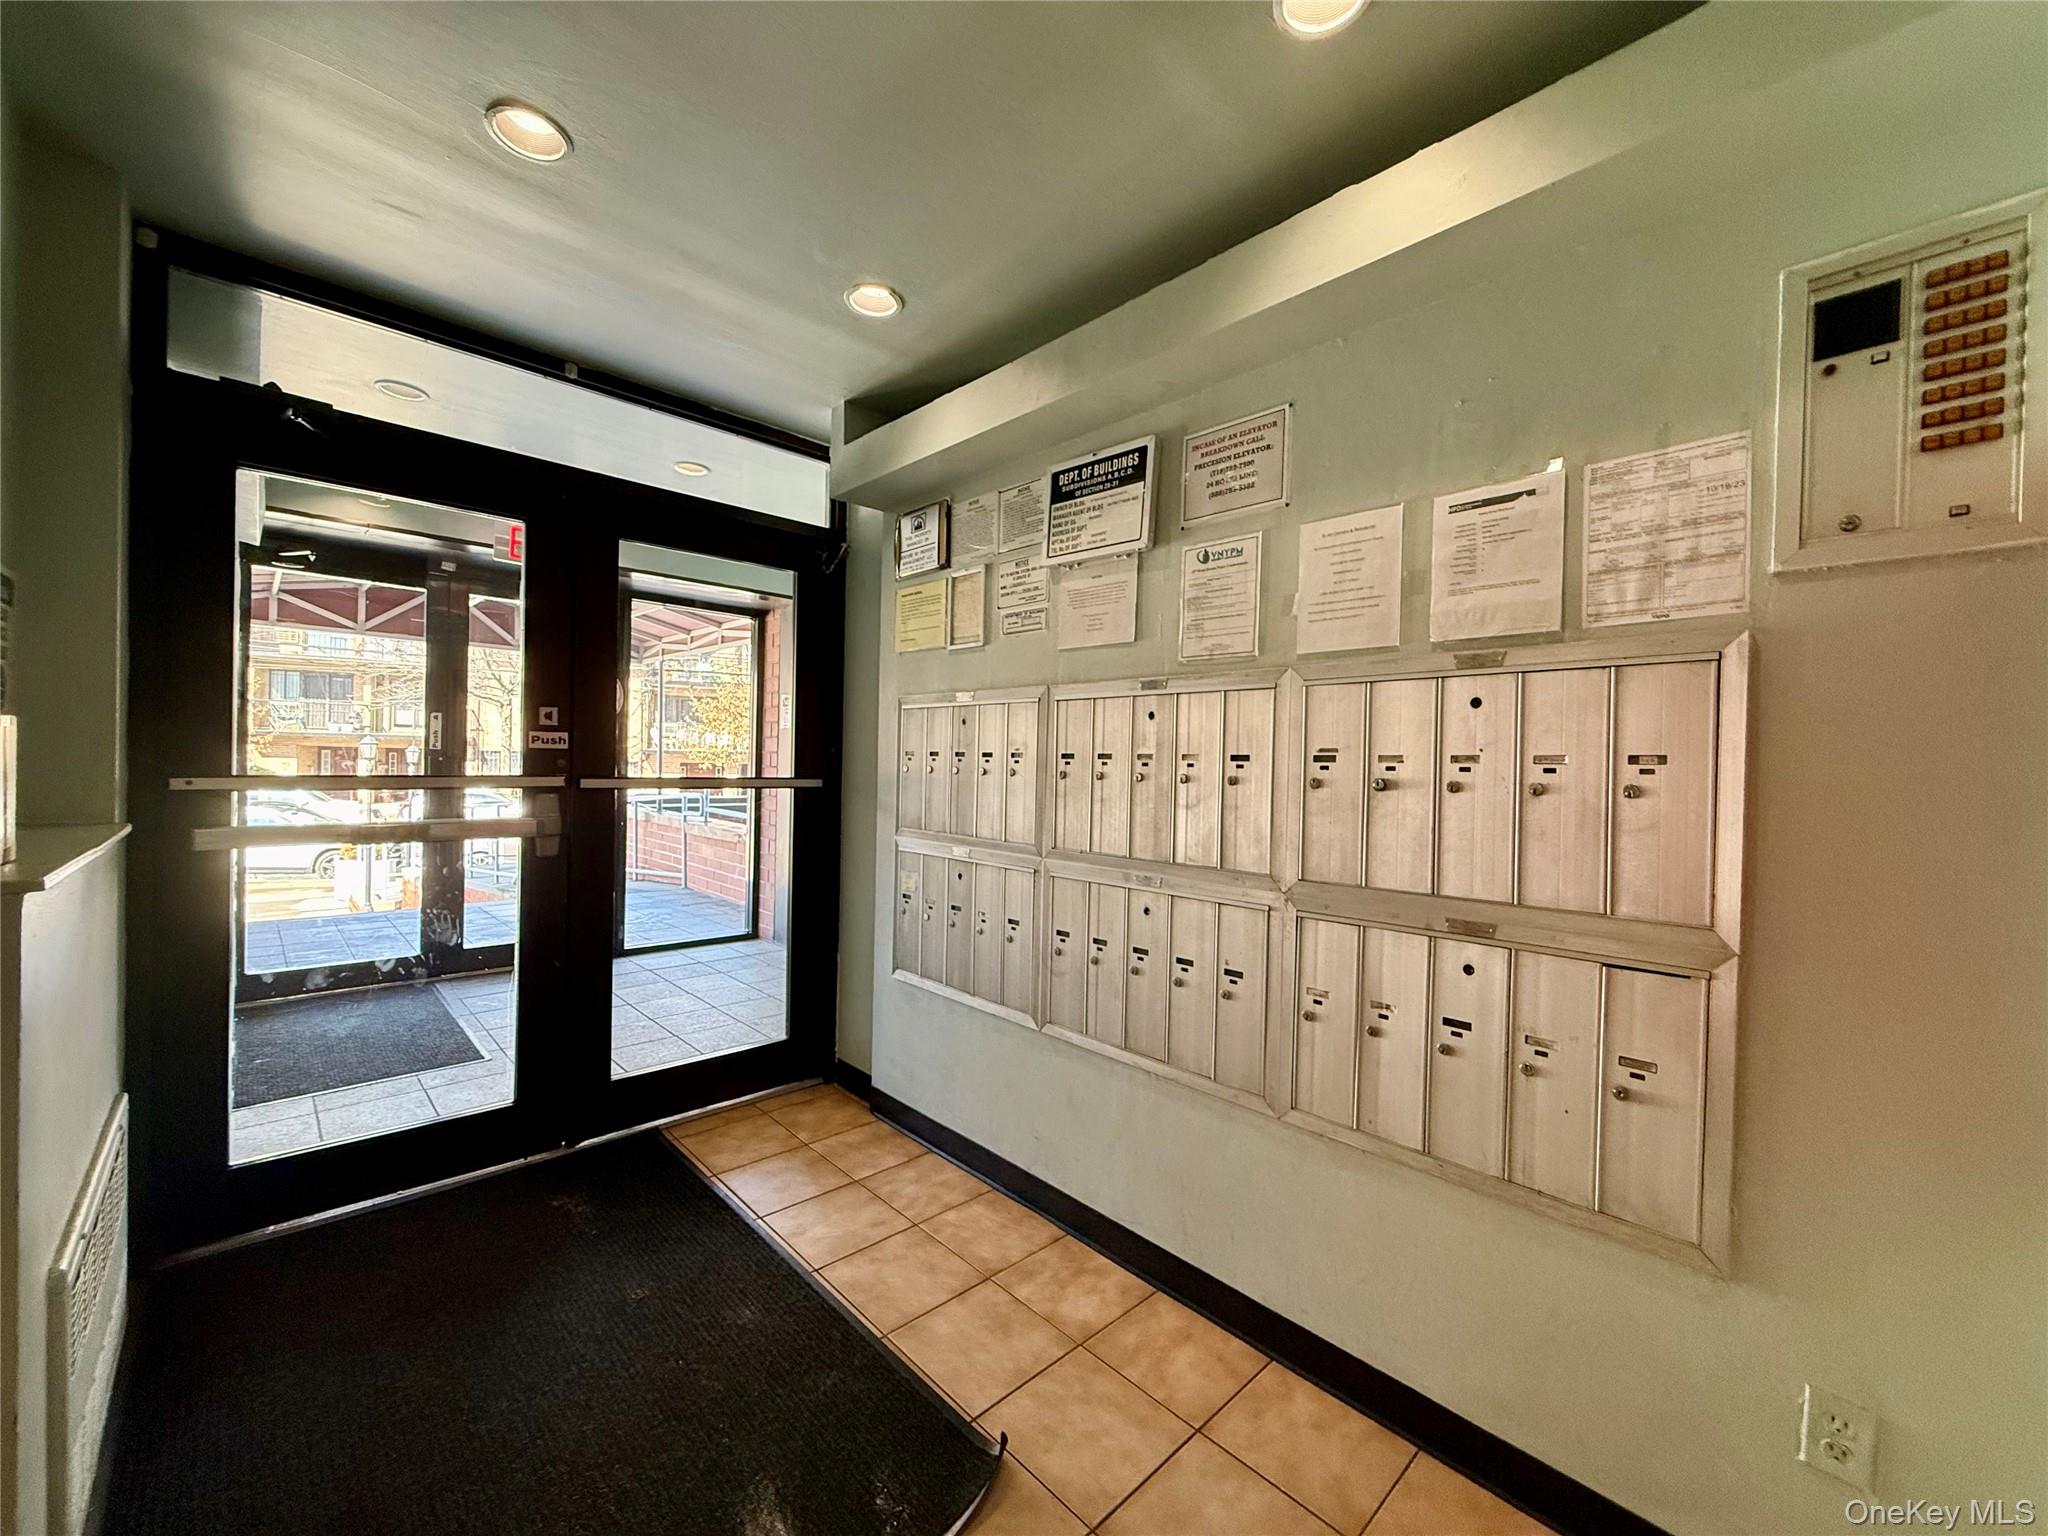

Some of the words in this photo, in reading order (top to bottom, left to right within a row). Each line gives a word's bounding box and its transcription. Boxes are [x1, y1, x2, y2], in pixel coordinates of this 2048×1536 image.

[1216, 436, 1226, 444] OF
[1228, 433, 1237, 441] AN
[1239, 420, 1278, 437] ELEVATOR
[1200, 442, 1245, 458] BREAKDOWN
[1246, 434, 1265, 445] CALL
[1059, 470, 1080, 486] DEPT.
[1082, 466, 1092, 480] OF
[1093, 452, 1139, 477] BUILDINGS
[1061, 475, 1107, 492] SUBDIVISIONS
[1075, 489, 1082, 497] OF
[1082, 484, 1103, 496] SECTION
[1210, 547, 1243, 560] VNYPM
[530, 734, 567, 745] Push
